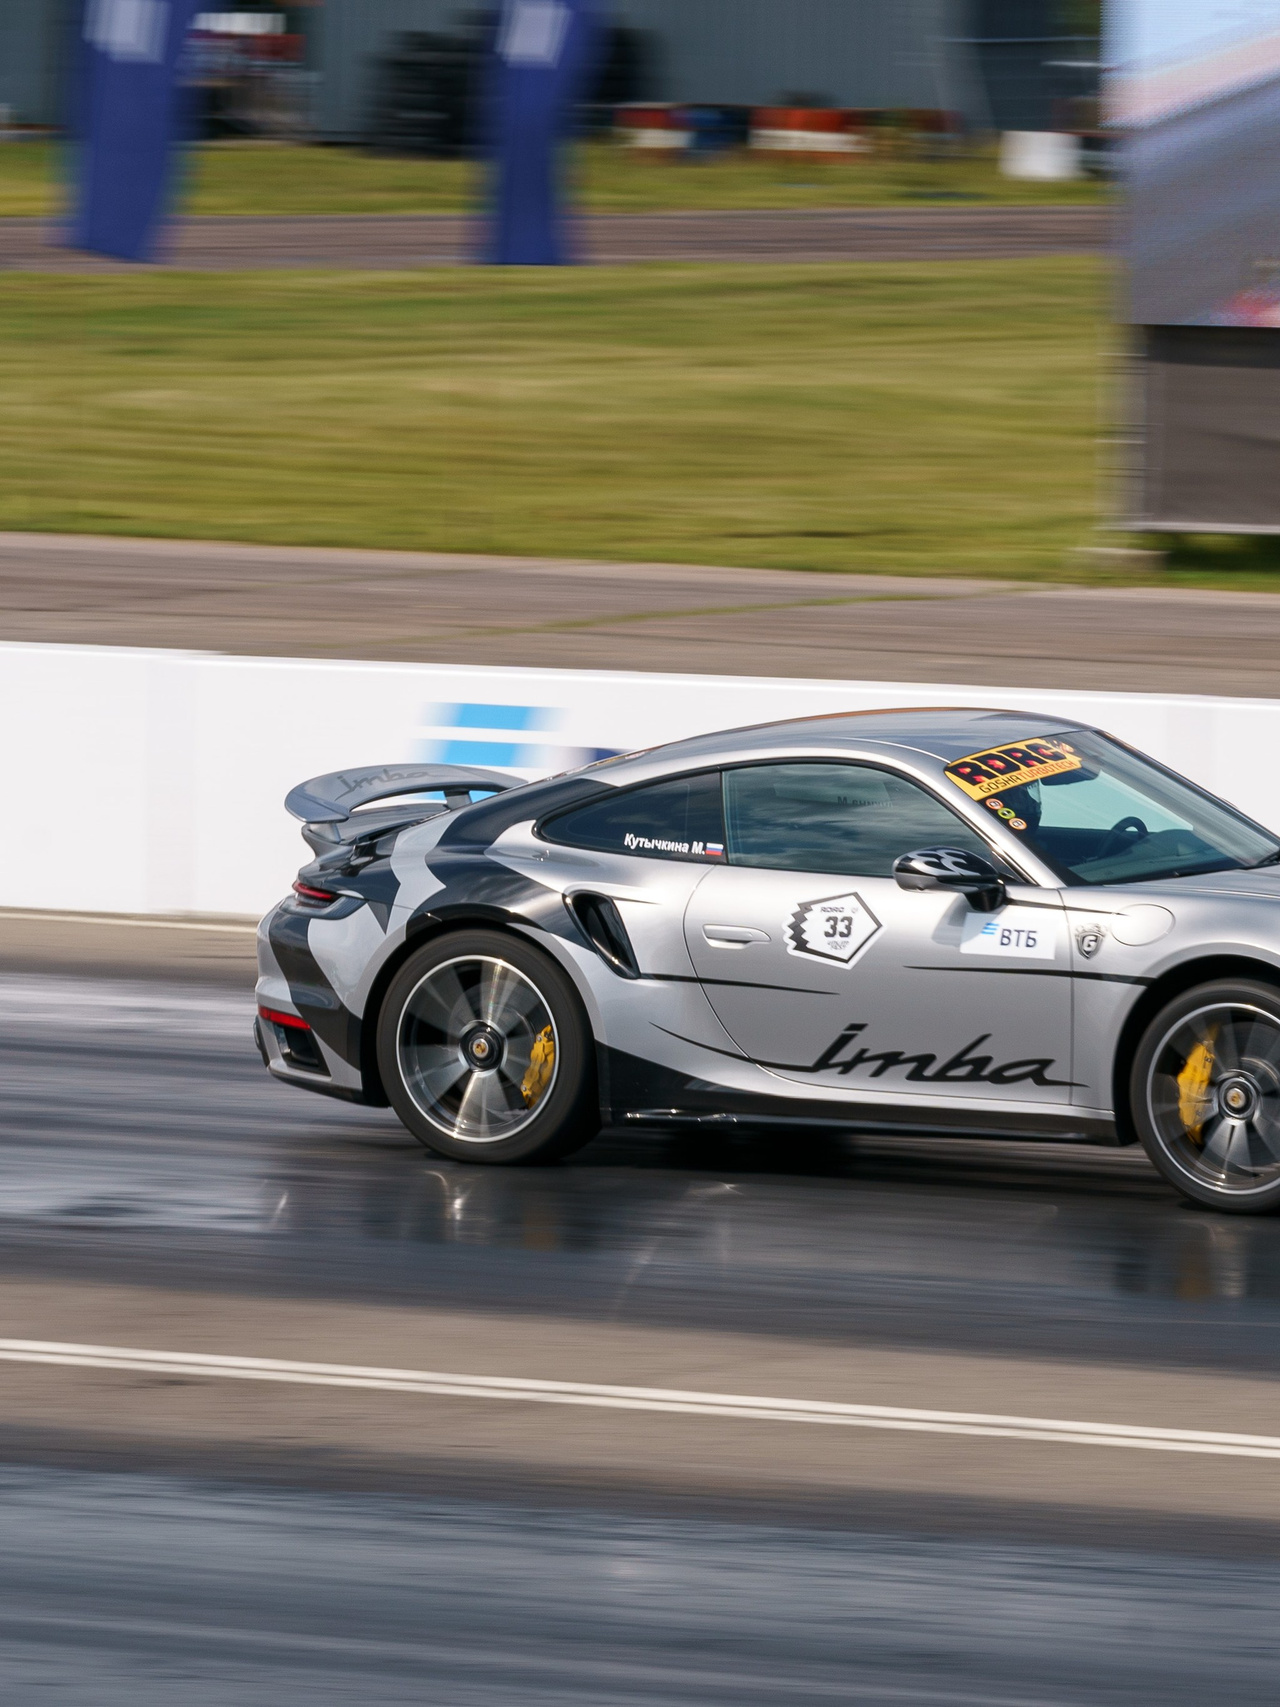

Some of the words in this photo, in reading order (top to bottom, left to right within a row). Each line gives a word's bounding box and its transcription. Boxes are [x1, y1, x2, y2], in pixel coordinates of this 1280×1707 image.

[944, 743, 1067, 786] RDRC
[336, 767, 434, 799] imba
[624, 832, 690, 854] Кутычкина
[691, 840, 706, 855] М.
[824, 916, 853, 938] 33
[999, 928, 1038, 948] ВТБ
[811, 1023, 1091, 1085] imba
